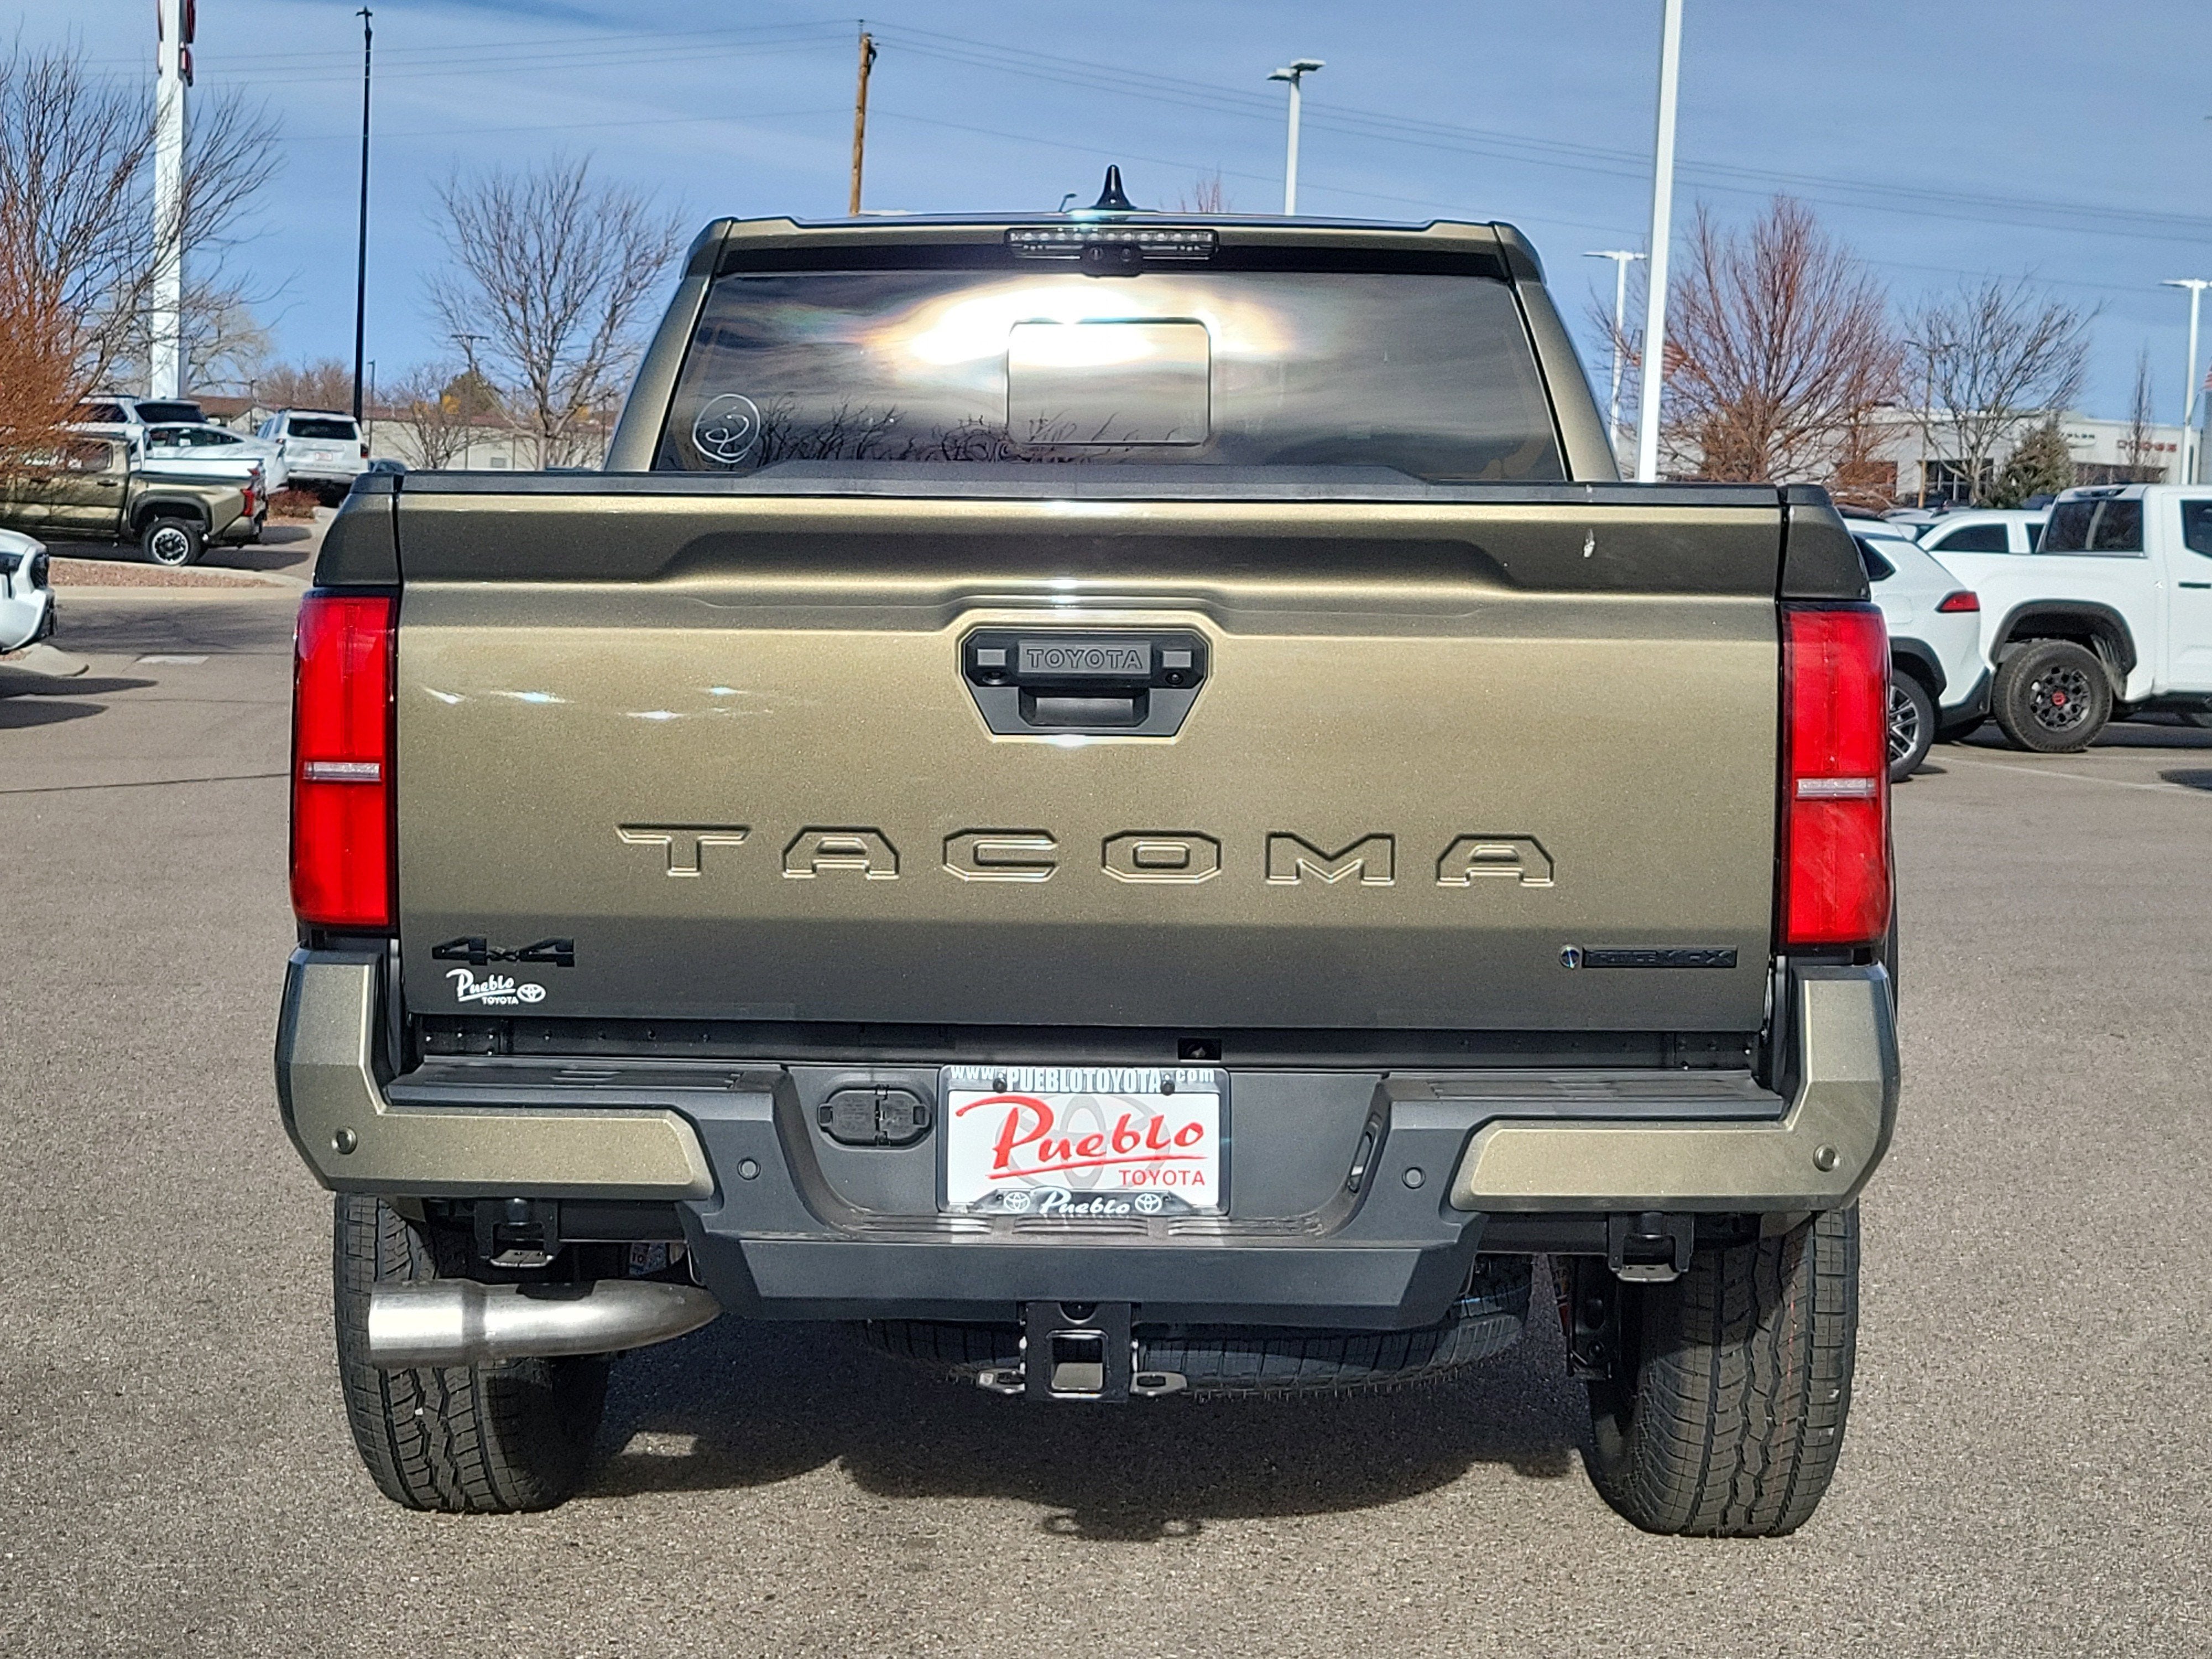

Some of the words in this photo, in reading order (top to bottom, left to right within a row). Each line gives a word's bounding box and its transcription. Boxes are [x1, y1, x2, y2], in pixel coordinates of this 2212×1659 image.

[1027, 649, 1143, 669] TOYOTA
[616, 824, 1555, 888] TACOMA
[446, 968, 515, 998] Pueblo
[482, 997, 519, 1005] TOYOTA
[956, 1095, 1204, 1169] Pueblo
[1118, 1170, 1205, 1186] TOYOTA
[1030, 1187, 1131, 1214] Pueblo
